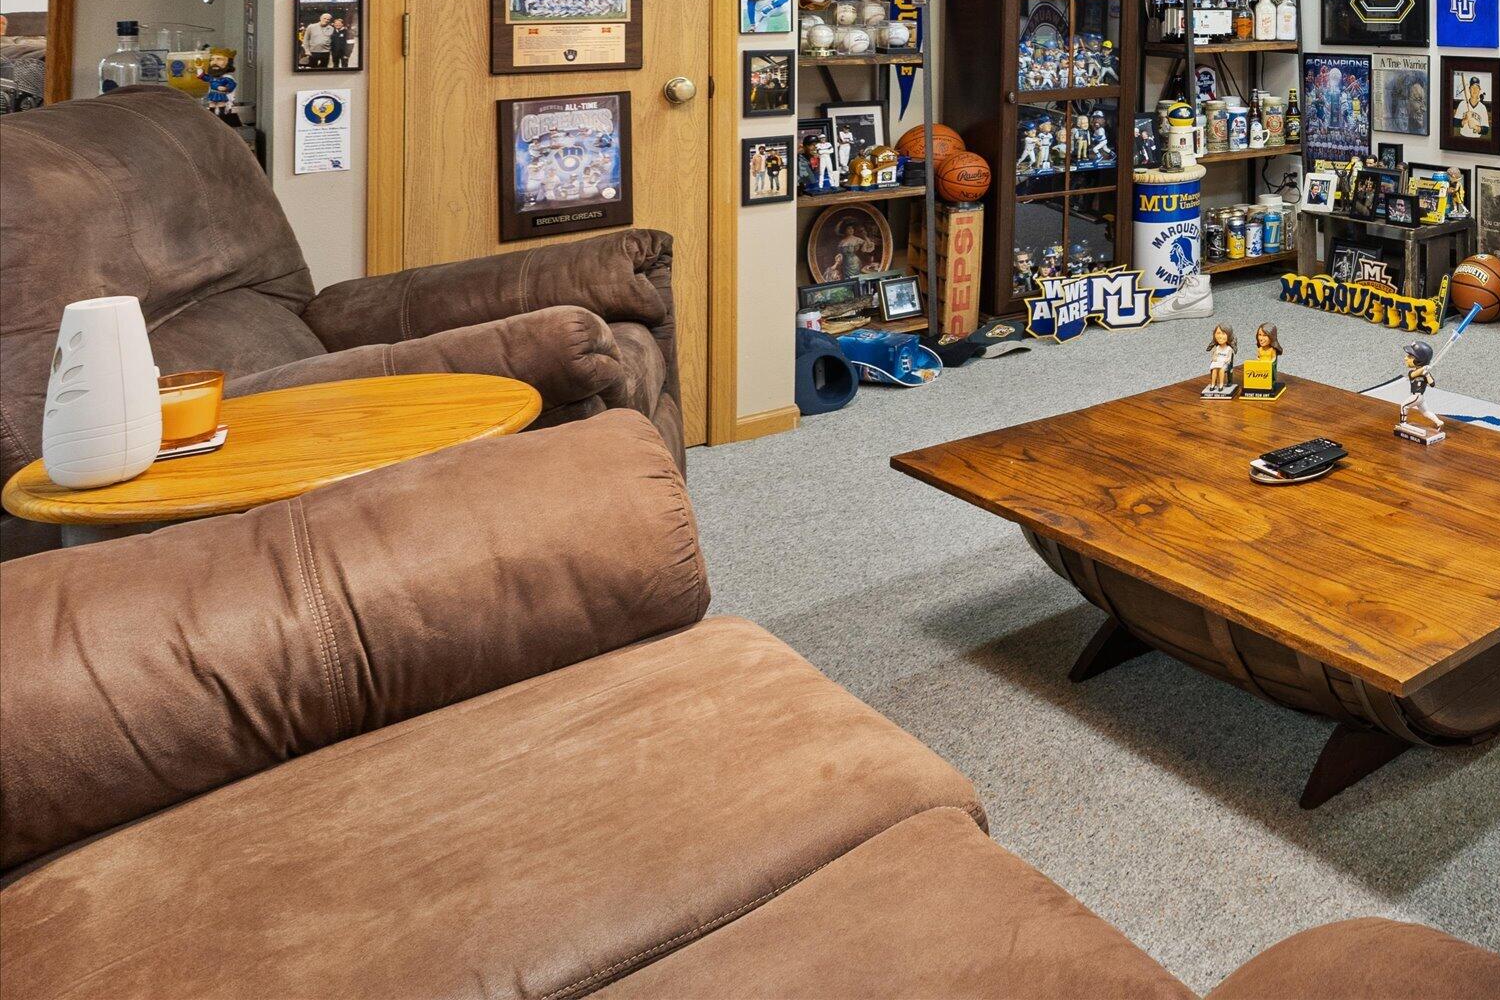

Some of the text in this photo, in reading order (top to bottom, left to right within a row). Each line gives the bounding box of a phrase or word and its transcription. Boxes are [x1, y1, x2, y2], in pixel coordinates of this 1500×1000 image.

[1314, 58, 1370, 68] CHAMPIONS
[1380, 59, 1427, 70] A True Warrior
[1139, 194, 1180, 213] MU
[536, 210, 603, 226] BREWER GREATS
[950, 214, 975, 338] PEPSI
[1064, 277, 1088, 302] WE
[1089, 274, 1147, 327] MU
[1280, 275, 1437, 335] MARQUETTE
[1057, 300, 1088, 326] ARE
[1246, 369, 1270, 379] Amy
